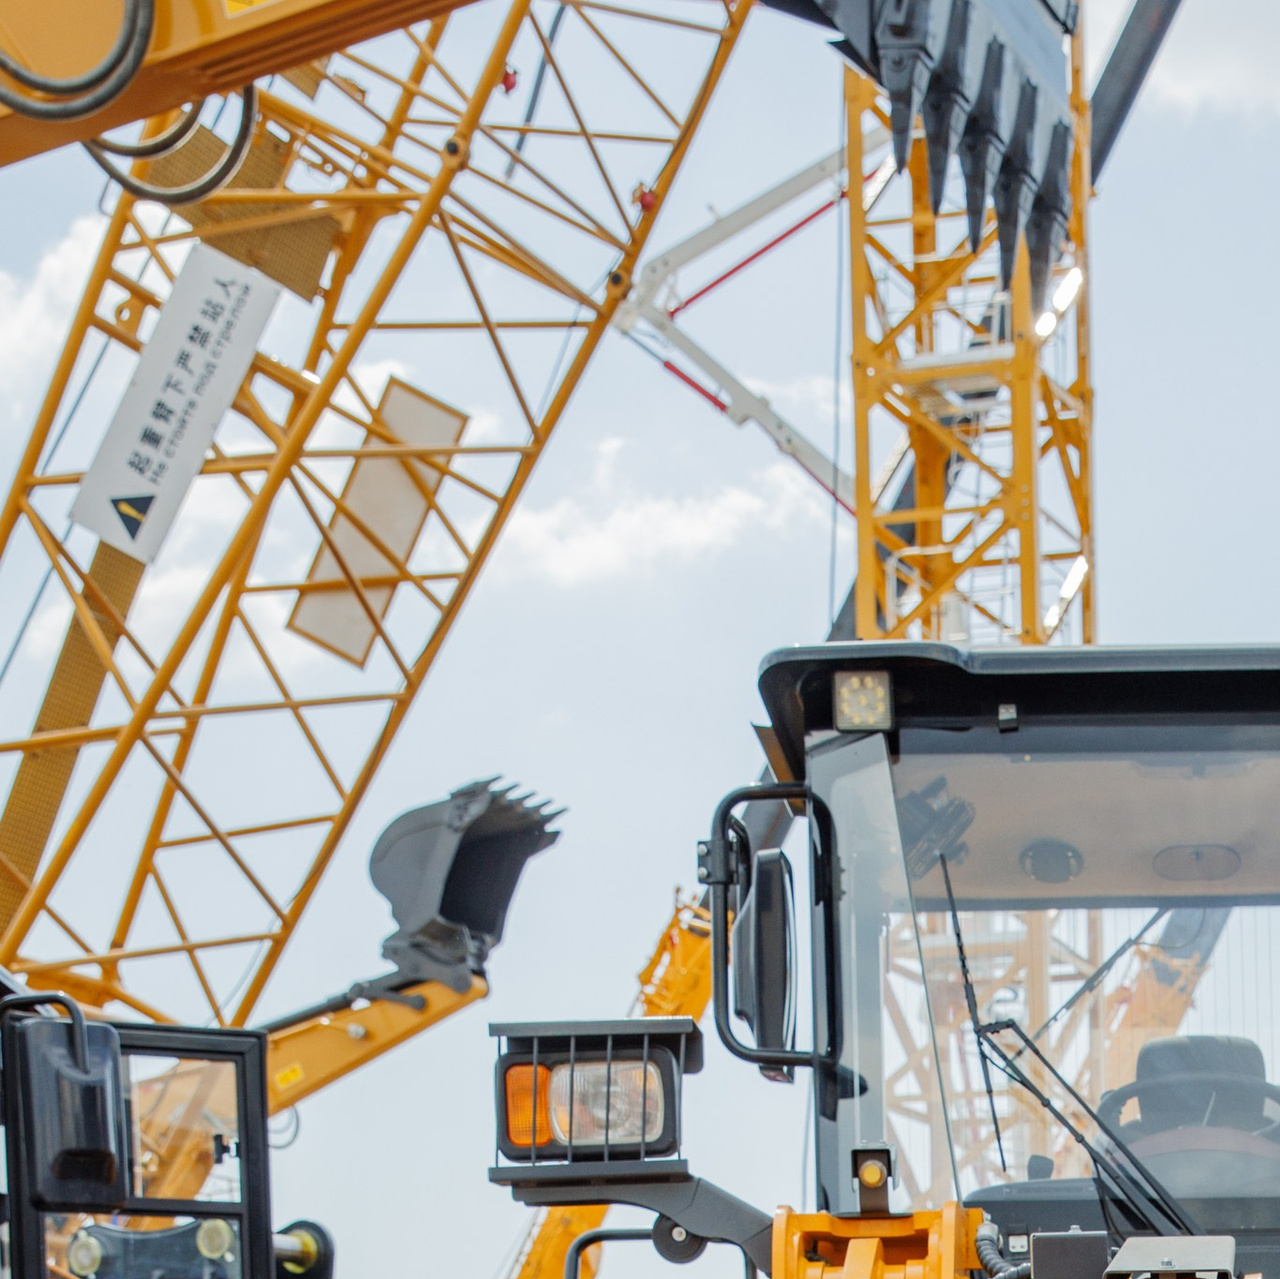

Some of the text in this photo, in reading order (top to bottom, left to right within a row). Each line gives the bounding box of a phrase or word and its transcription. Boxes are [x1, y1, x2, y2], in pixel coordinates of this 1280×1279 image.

[126, 276, 236, 476] 起重臂下严禁站人
[148, 282, 252, 486] Не стойте под стрелой
